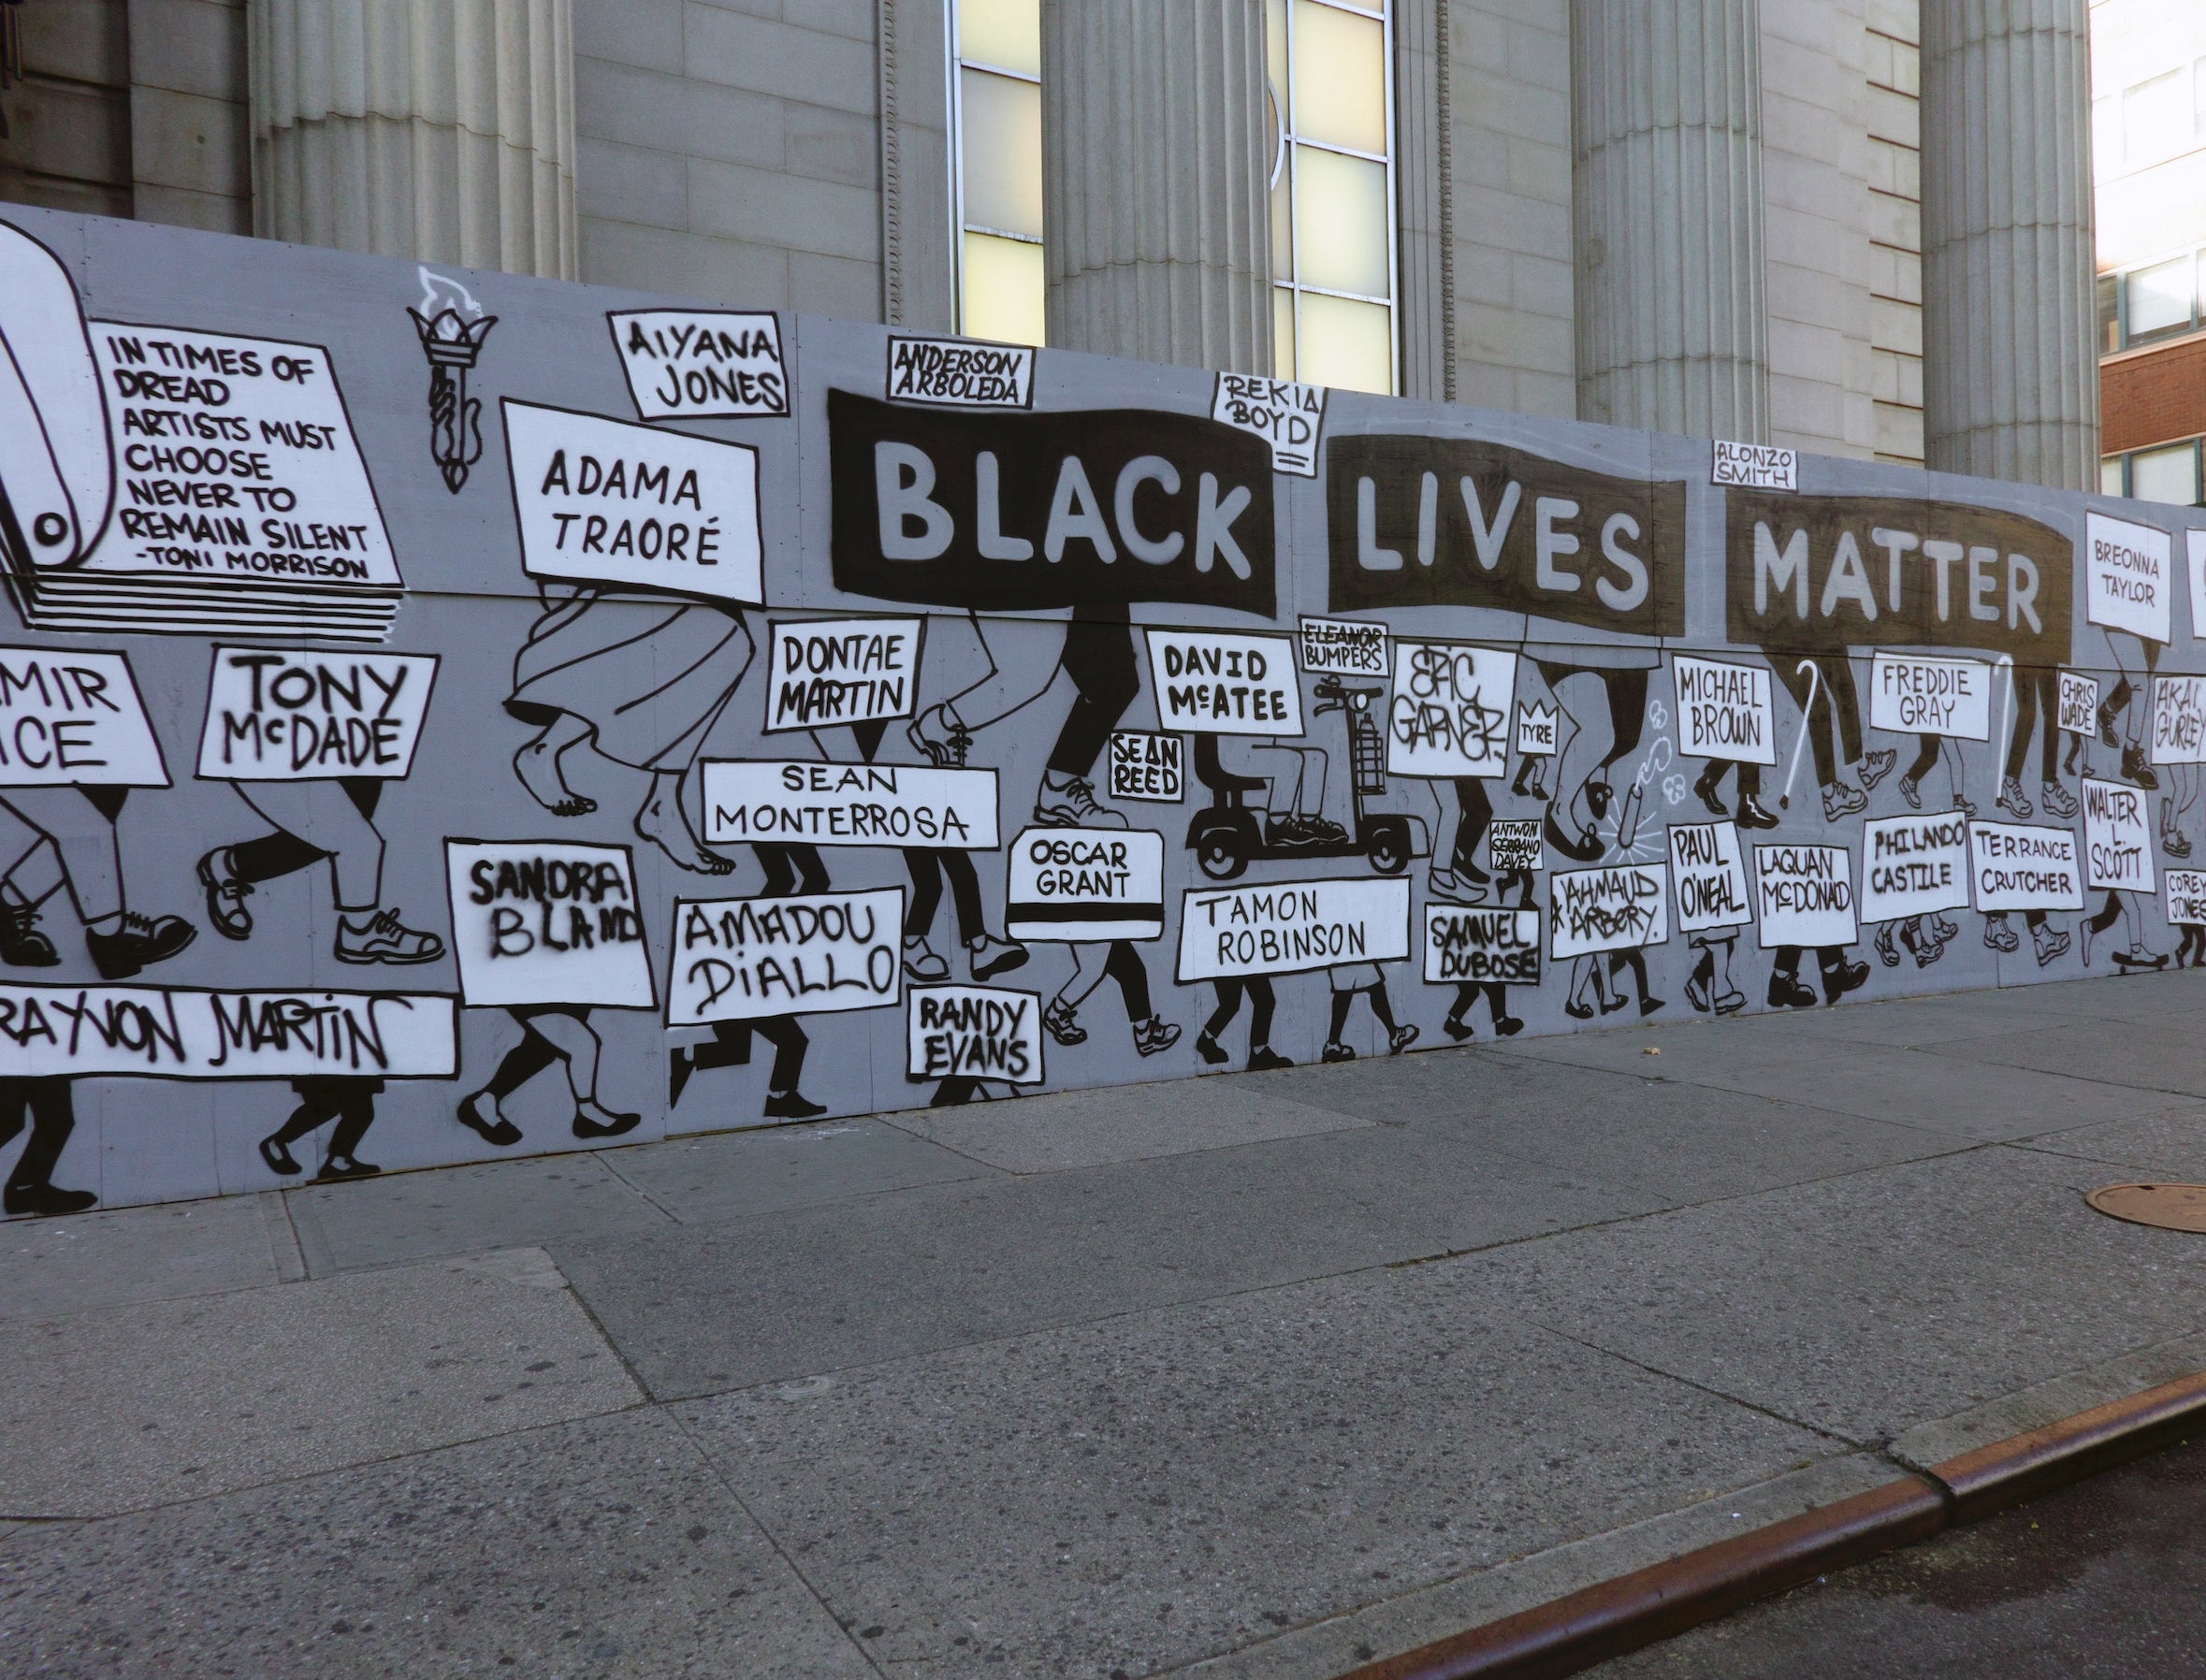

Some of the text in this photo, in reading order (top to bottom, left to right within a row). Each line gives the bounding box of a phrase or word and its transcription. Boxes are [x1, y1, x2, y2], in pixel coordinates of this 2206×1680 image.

[108, 336, 315, 384] IN TIMES OF
[628, 322, 778, 364] AIYANA
[894, 343, 1023, 377] ANDERSON
[113, 369, 230, 408] DREAD
[656, 366, 785, 412] JONES
[896, 372, 1019, 403] ARBOLEDA
[1224, 376, 1319, 413] REKIA
[123, 409, 336, 452] ARTISTS MUST
[1225, 399, 1310, 444] BOYD
[124, 444, 273, 481] CHOOSE
[1717, 442, 1792, 467] ALONZO
[541, 449, 702, 511] ADAMA
[1716, 461, 1789, 486] SMITH
[126, 479, 297, 513] NEVER TO
[119, 509, 367, 552] REMAIN SILENT
[552, 513, 721, 565] TRAORÉ
[874, 441, 2042, 634] BLACK LIVES MATTER
[225, 551, 369, 580] MORRISON
[2094, 540, 2159, 580] BREONNA
[2101, 572, 2155, 608] TAYLOR
[783, 635, 906, 673] DONTAE
[1304, 623, 1383, 649] ELEANOR
[1164, 645, 1267, 681] DAVID
[1304, 644, 1383, 671] BUMPERS
[0, 660, 121, 712] MIR
[229, 656, 409, 716] TONY
[1679, 667, 1763, 707] MICHAEL
[1882, 664, 1973, 697] FREDDIE
[2061, 679, 2095, 708] CHRIS
[2156, 679, 2199, 711] AKAI
[776, 677, 906, 724] MARTIN
[1168, 685, 1287, 721] McATEE
[1900, 696, 1956, 730] GRAY
[2061, 706, 2093, 731] WADE
[222, 711, 403, 771] McDADE
[1520, 723, 1554, 745] TYRE
[1691, 705, 1761, 747] BROWN
[1111, 735, 1178, 771] SEAN
[782, 765, 899, 794] SEAN
[1114, 768, 1178, 795] REED
[716, 805, 969, 841] MONTERROSA
[2085, 784, 2141, 828] WALTER
[1491, 822, 1539, 838] ANTWON
[1673, 823, 1731, 866] PAUL
[1874, 821, 1965, 860] PHILANDO
[1976, 830, 2072, 861] TERRANCE
[2111, 824, 2126, 847] L.
[1029, 841, 1126, 868] OSCAR
[1494, 852, 1536, 869] DAVEY
[1759, 847, 1833, 879] LAQUAN
[2091, 842, 2142, 881] SCOTT
[471, 859, 630, 905] SANDRA
[1037, 869, 1130, 897] GRANT
[1560, 869, 1659, 914] AHMAUD
[1680, 869, 1745, 919] O'NEAL
[1872, 863, 1952, 895] CASTILE
[1981, 869, 2073, 895] CRUTCHER
[685, 903, 876, 949] AMADOU
[1197, 890, 1318, 929] TAMON
[489, 902, 642, 959] BLAND
[1217, 921, 1366, 964] ROBINSON
[1430, 913, 1531, 949] SAMUEL
[1441, 944, 1539, 979] DUBOSE
[920, 996, 1027, 1036] RANDY
[924, 1033, 1029, 1076] EVANS
